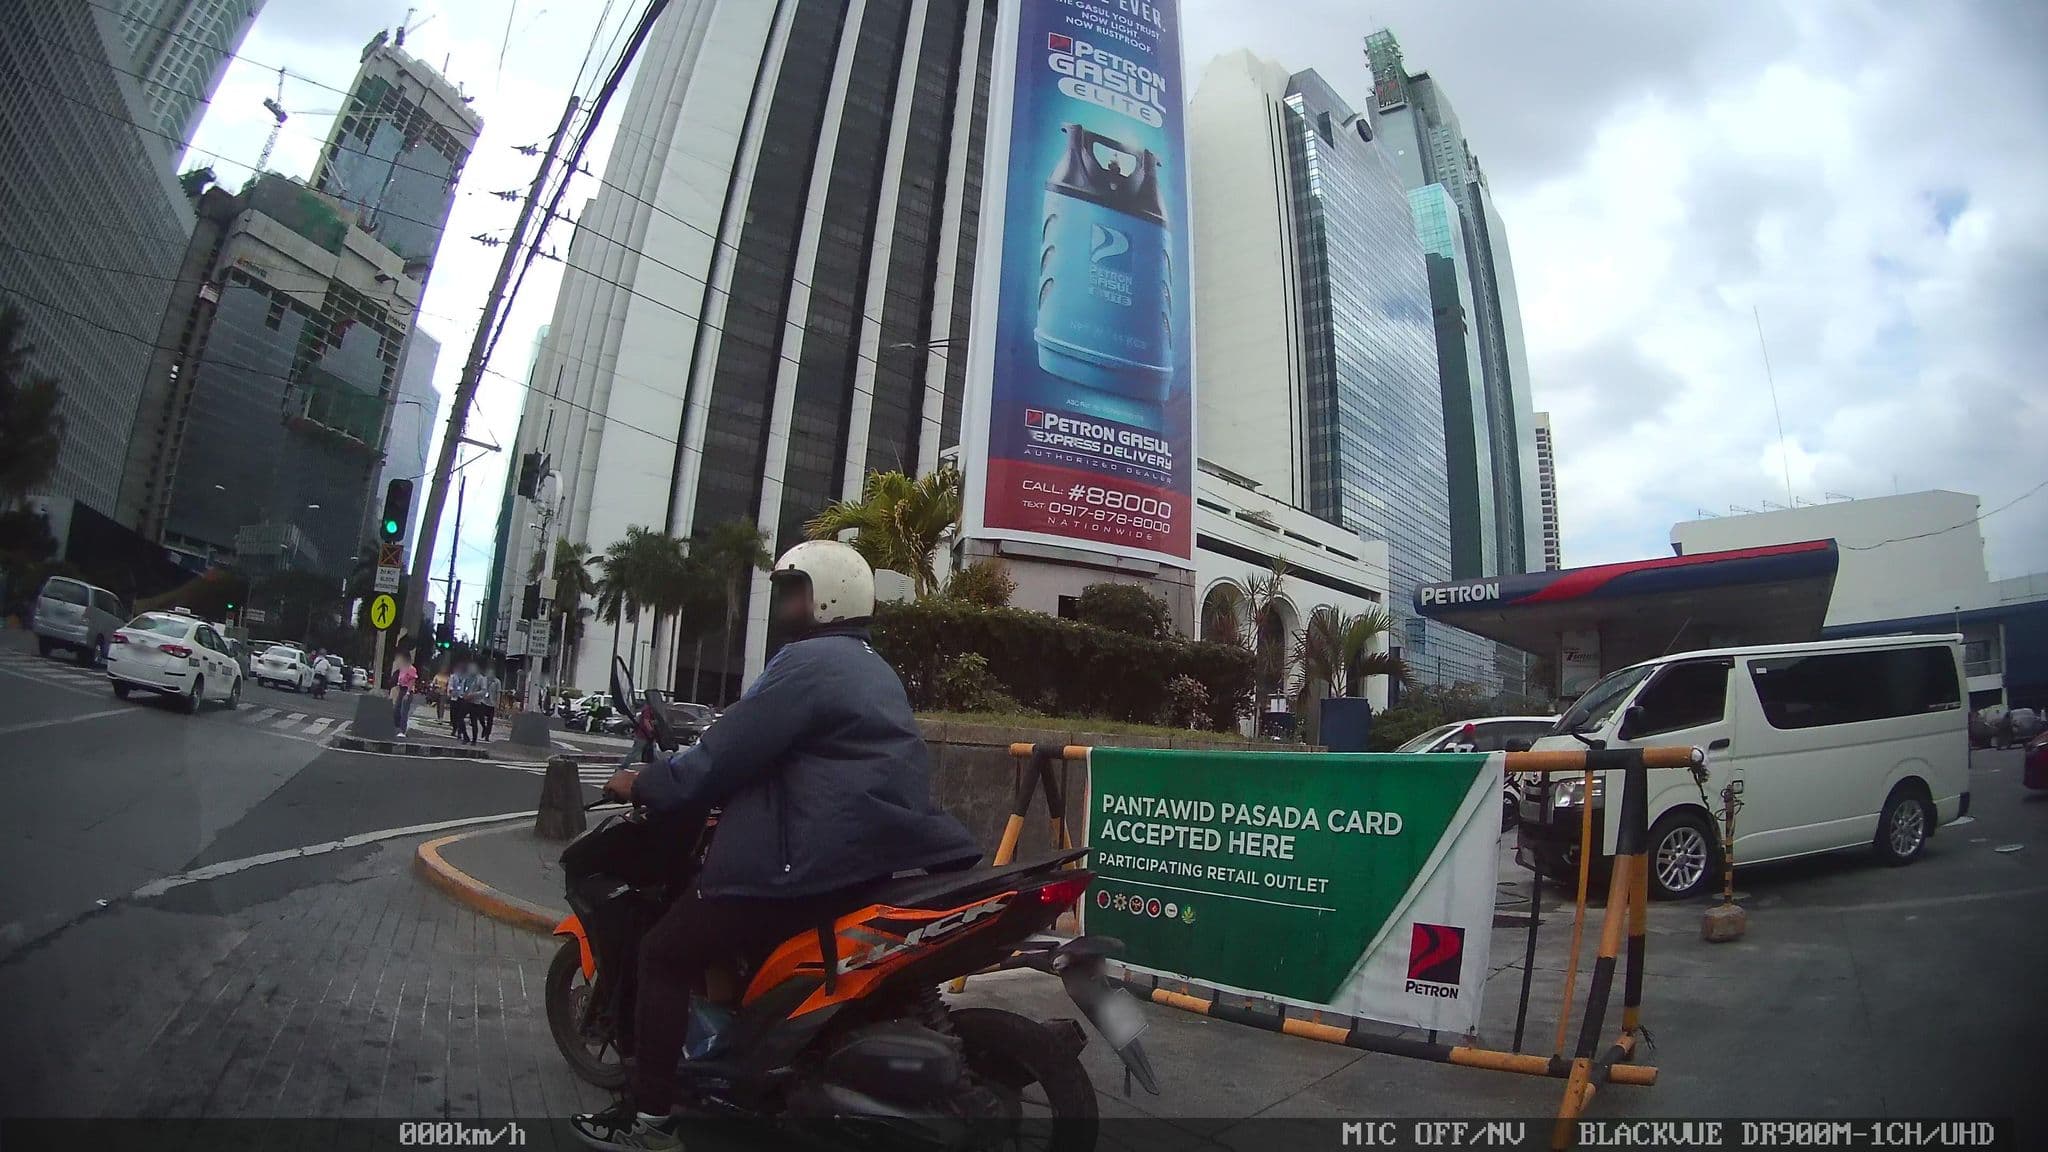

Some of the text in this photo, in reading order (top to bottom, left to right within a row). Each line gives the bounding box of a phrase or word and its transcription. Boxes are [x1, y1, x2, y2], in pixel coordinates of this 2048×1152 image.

[1065, 15, 1093, 30] NOW
[1075, 1, 1110, 18] GASUL
[1112, 12, 1133, 27] YOU
[1081, 11, 1108, 26] NOW
[1119, 0, 1166, 33] EVER.
[1048, 53, 1166, 114] GASUL
[1075, 40, 1165, 92] PETRON
[1074, 83, 1151, 121] ELITE
[1031, 431, 1172, 470] EXPRESS DELIVERY
[1044, 413, 1172, 457] PETRON GASUL
[1024, 449, 1173, 484] AUTHORIZED DEALER
[1022, 480, 1172, 519] CALL: #88000
[1047, 516, 1153, 541] NATIONWIDE
[1048, 502, 1171, 534] 0917-878-8000
[1421, 582, 1500, 606] PETRON
[1102, 793, 1403, 836] PANTAWID PASADA CARD
[1101, 819, 1296, 860] ACCEPTED HERE
[1099, 852, 1329, 894] PARTICIPATING RETAIL OUTLET
[1405, 981, 1459, 1000] PETRON
